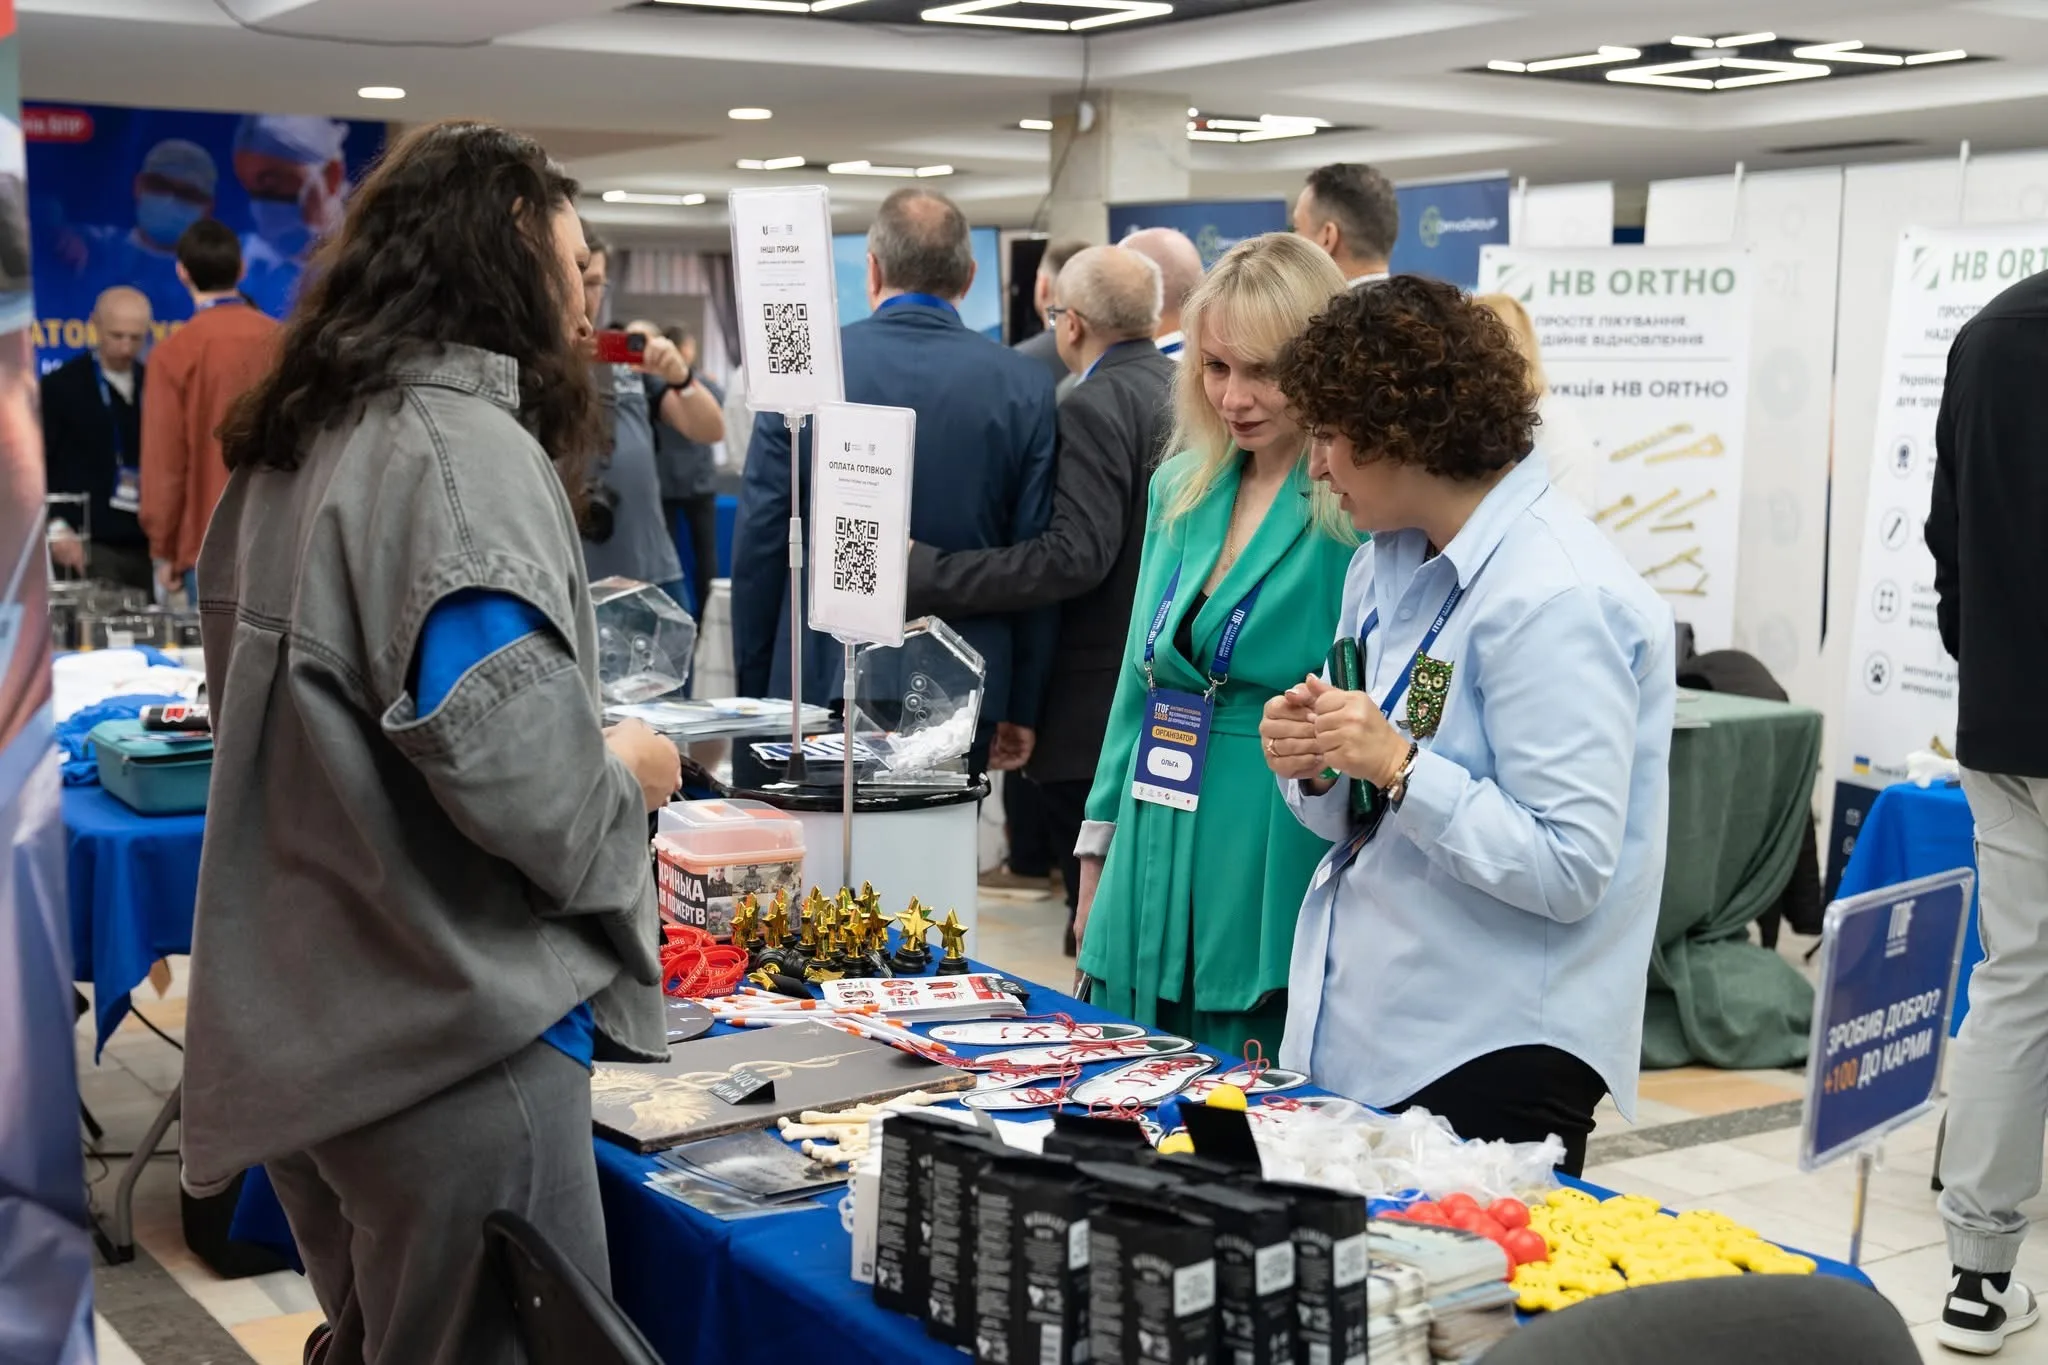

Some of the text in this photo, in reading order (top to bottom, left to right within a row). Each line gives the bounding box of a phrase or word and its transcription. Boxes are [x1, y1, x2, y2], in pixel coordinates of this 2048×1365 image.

[776, 245, 800, 253] ПРИЗИ
[1951, 250, 1988, 282] HB
[1549, 268, 1736, 296] HB ORTHO
[1535, 315, 1593, 328] ПРОСТЕ
[1541, 333, 1704, 347] ДІЙНЕ ВІДНОВЛЕННЯ
[1549, 379, 1729, 399] укція HB ORTHO
[829, 461, 893, 476] ОПЛАТА ГОТІВКОЮ
[1232, 608, 1246, 626] ITOF
[1431, 615, 1445, 633] ITOF
[1147, 630, 1157, 645] ITOF
[1155, 702, 1170, 713] ITOF
[1155, 728, 1194, 743] ОРГАНІЗАТОР
[1161, 759, 1179, 769] ОЛЬГА
[658, 861, 706, 903] КРИНЬКА
[667, 893, 706, 925] ПОЖЕРТВ
[1826, 987, 1942, 1056] ЗРОБИВ ДОБРО?
[1824, 1028, 1933, 1094] +100 ДО КАРМИ
